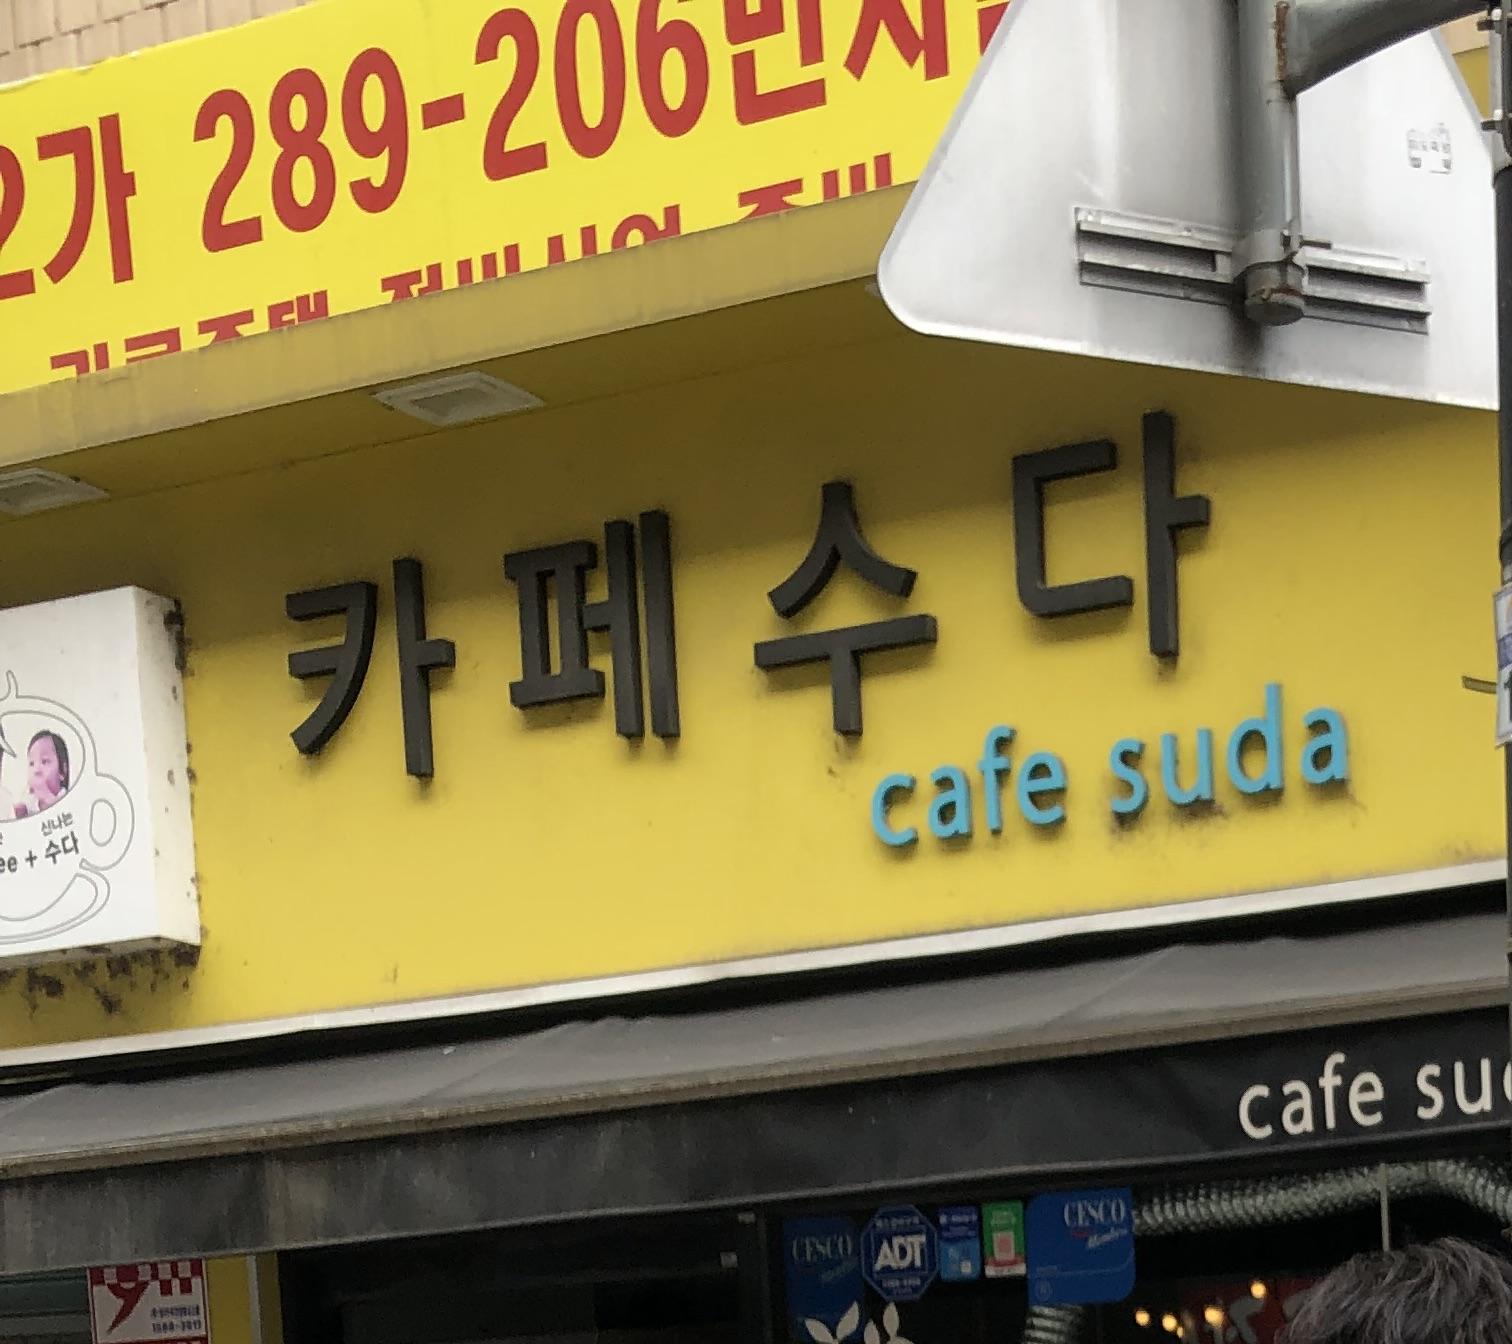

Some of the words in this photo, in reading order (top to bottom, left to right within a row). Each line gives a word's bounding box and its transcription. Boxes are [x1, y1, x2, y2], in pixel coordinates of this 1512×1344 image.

[193, 0, 1010, 255] 289-206번지
[871, 725, 1066, 848] cafe
[1109, 682, 1351, 817] suda
[41, 812, 74, 837] 신나는
[45, 831, 79, 864] 수다
[1239, 1051, 1385, 1139] cafe
[874, 1233, 927, 1273] ADT
